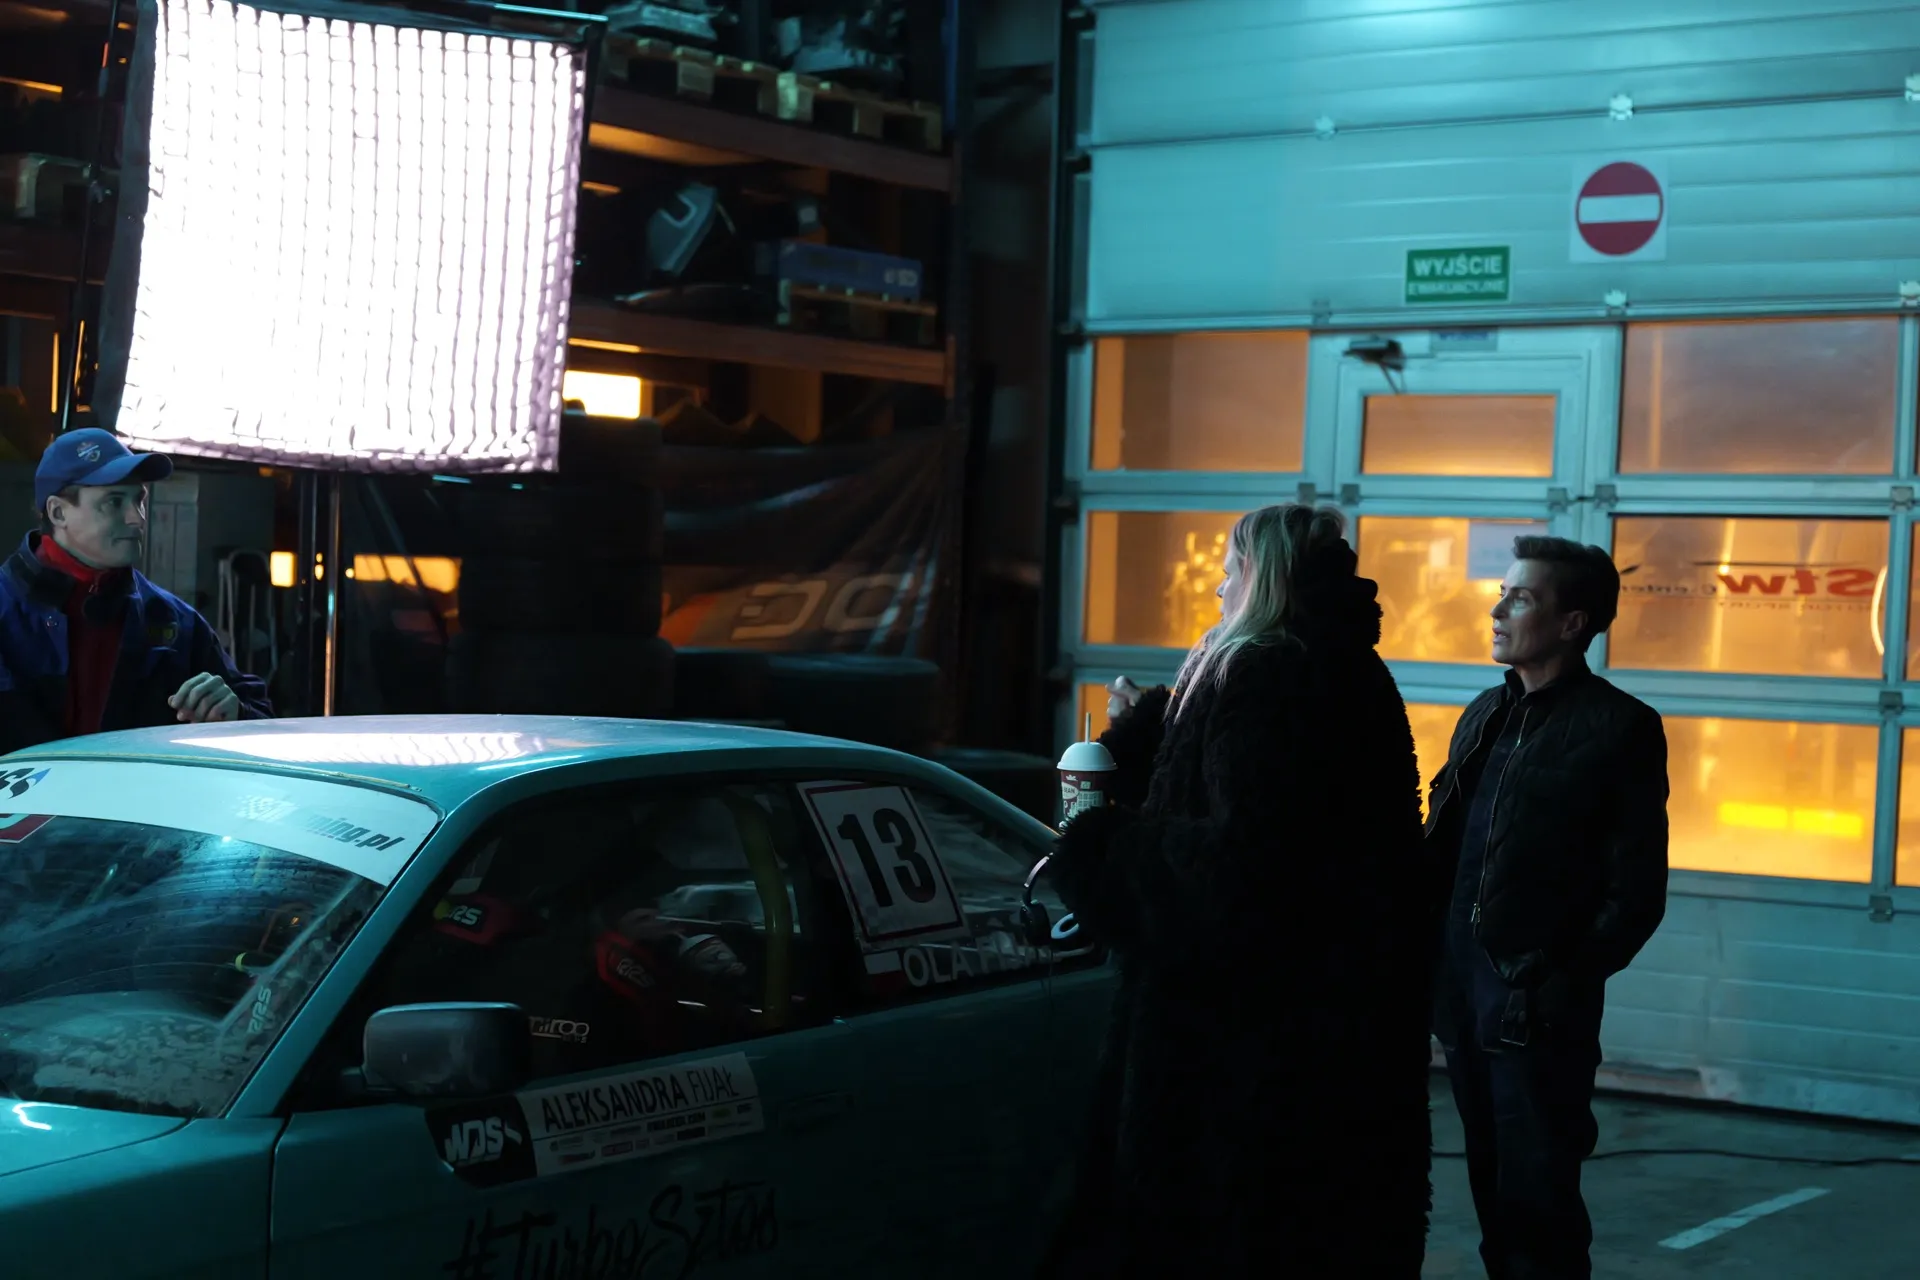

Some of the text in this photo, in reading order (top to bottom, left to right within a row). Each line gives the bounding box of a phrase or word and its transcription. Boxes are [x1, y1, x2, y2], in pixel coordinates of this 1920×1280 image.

[1413, 252, 1503, 277] WYJŚCIE
[836, 808, 936, 907] 13
[903, 942, 975, 988] OLA
[541, 1065, 740, 1133] ALEKSANDRA FIJAŁ
